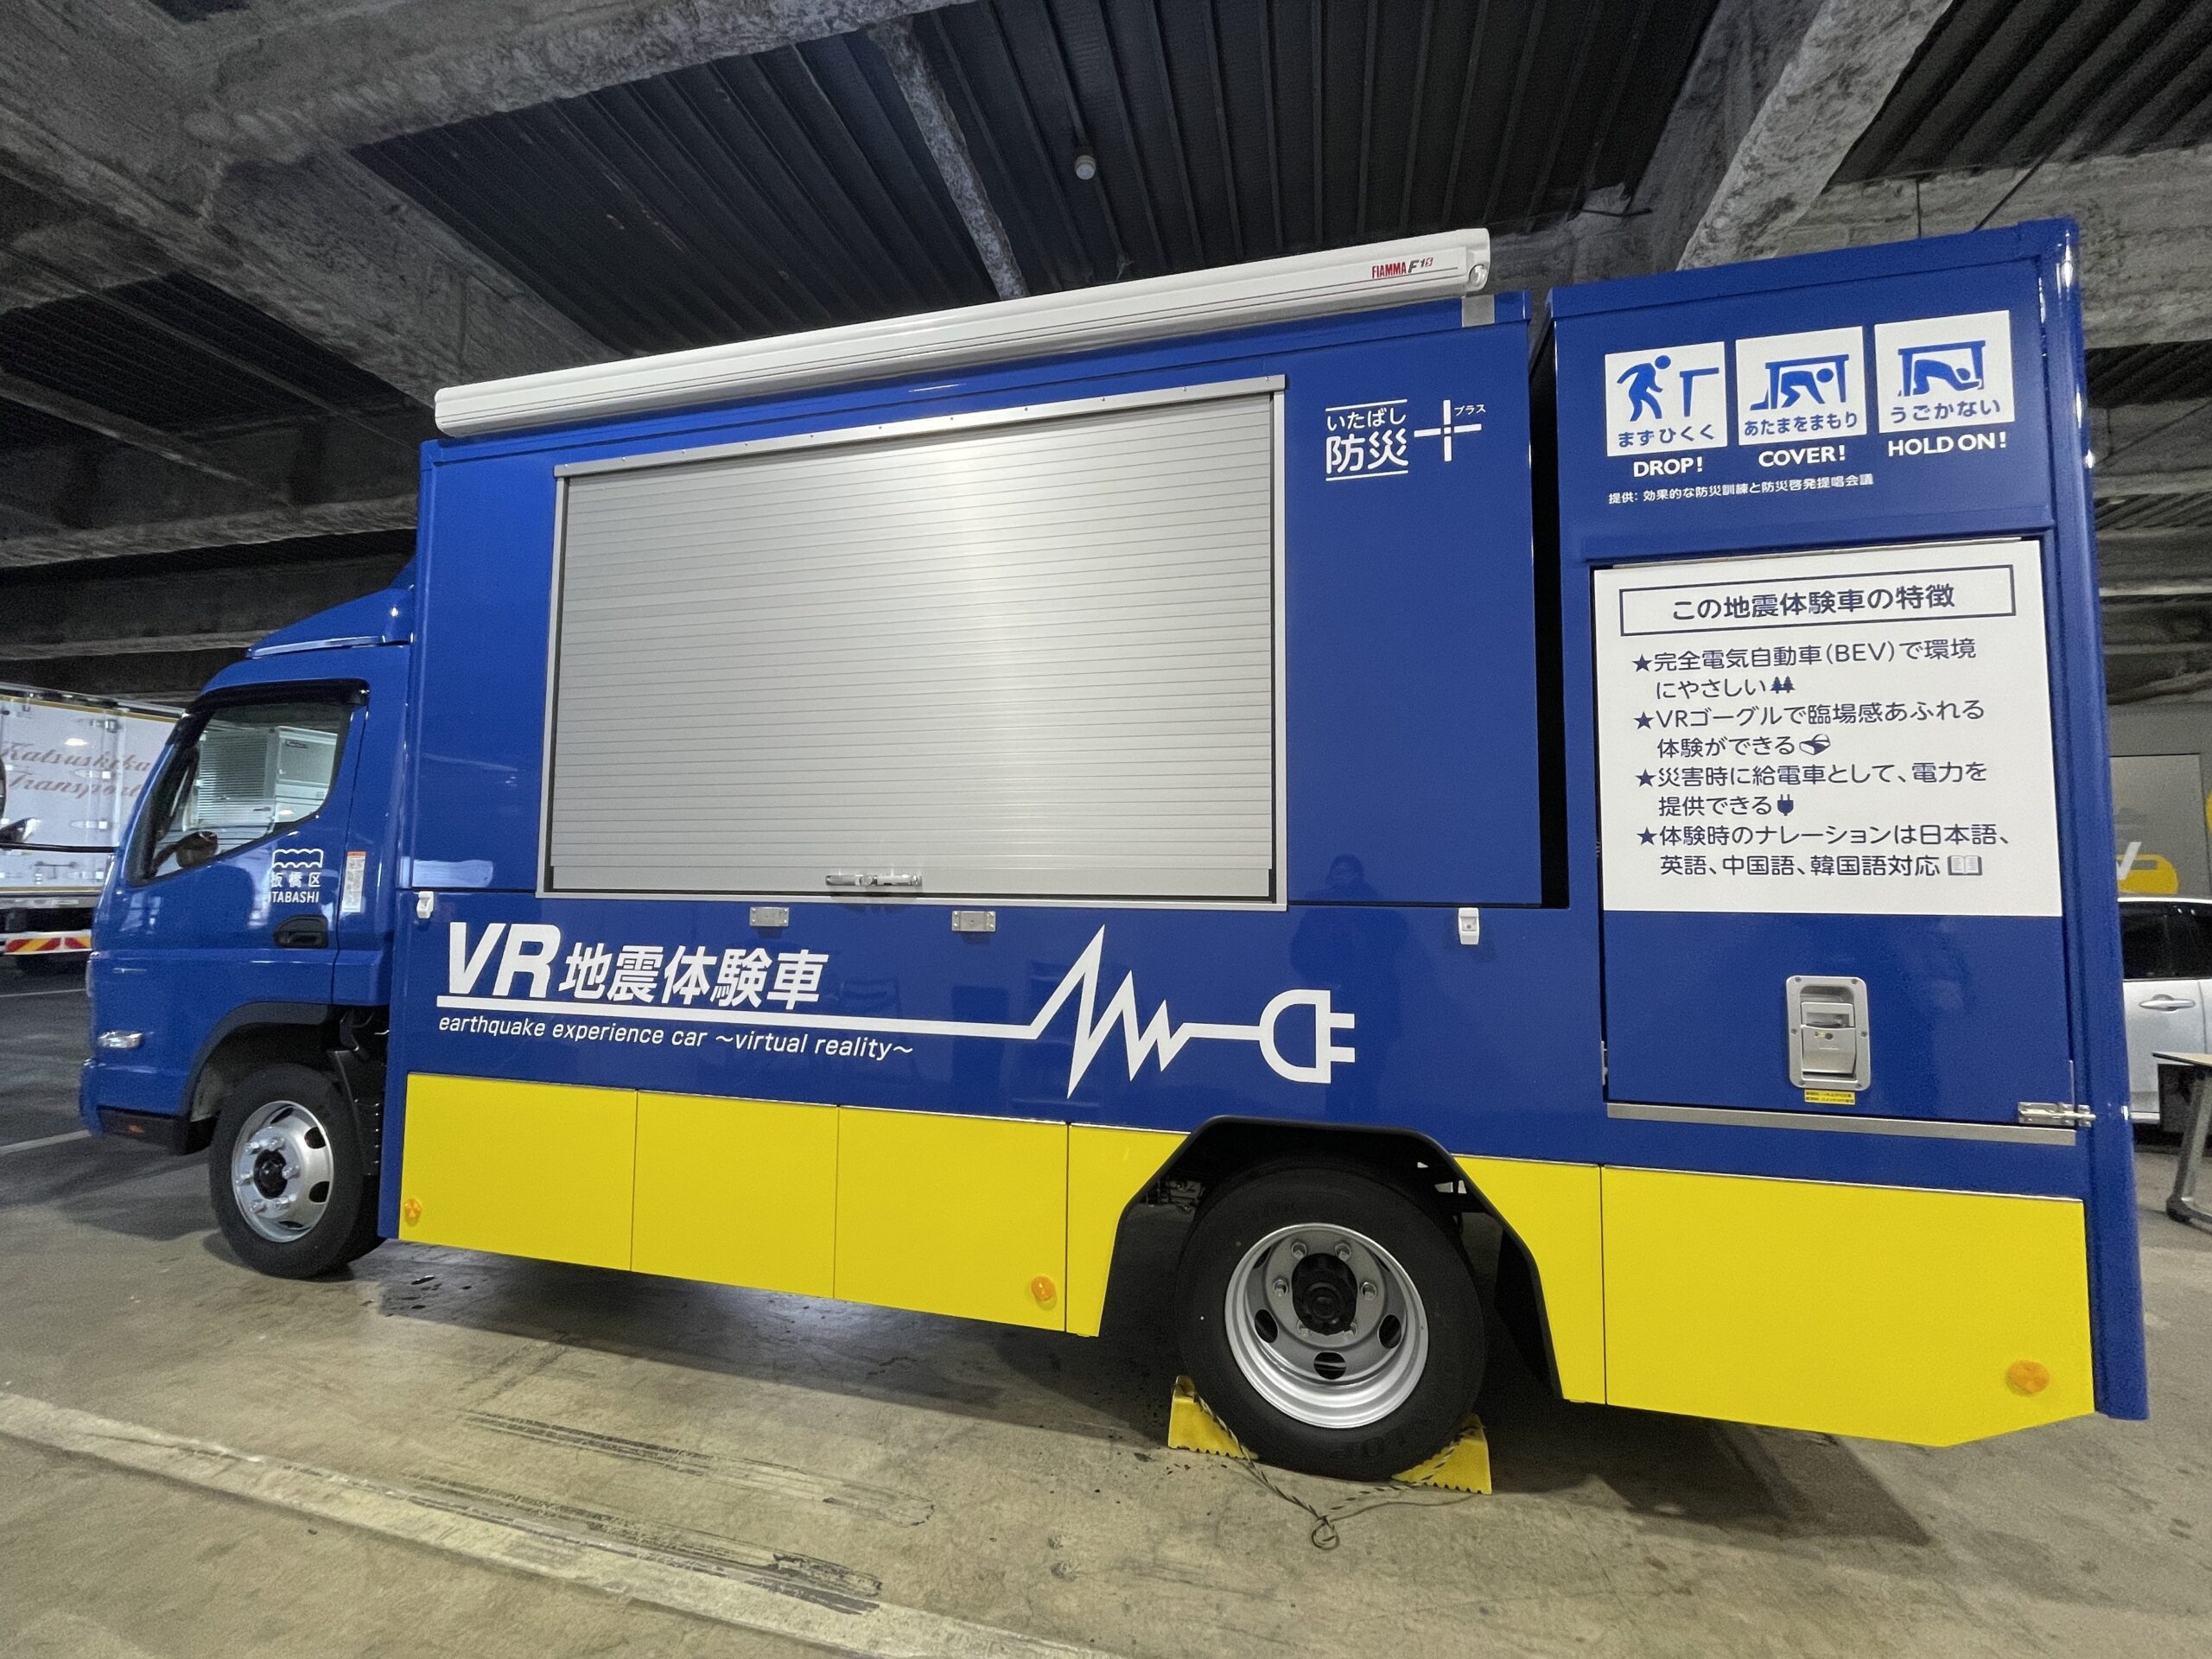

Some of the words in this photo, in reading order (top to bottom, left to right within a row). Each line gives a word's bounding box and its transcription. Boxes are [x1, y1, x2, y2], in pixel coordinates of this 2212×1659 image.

[1372, 262, 1407, 278] FIAMMA
[1327, 408, 1406, 431] いたばし
[1454, 404, 1485, 416] プラス
[1891, 398, 1999, 423] うごかない
[1745, 412, 1857, 435] あたまをまもり
[1618, 424, 1713, 447] まずひくく
[1889, 436, 1952, 456] HOLD
[1958, 431, 2006, 451] ON!
[1326, 429, 1408, 474] 防災
[1758, 445, 1845, 467] COVER!
[1634, 456, 1702, 477] DROP!
[1674, 584, 1955, 620] この地震体験車の特徴
[1657, 679, 1765, 699] にやさしい
[1657, 736, 1794, 758] 体験ができる
[1659, 797, 1771, 816] 提供できる
[440, 1016, 545, 1036] earthquake
[553, 1023, 664, 1044] experience
[672, 1031, 708, 1046] car
